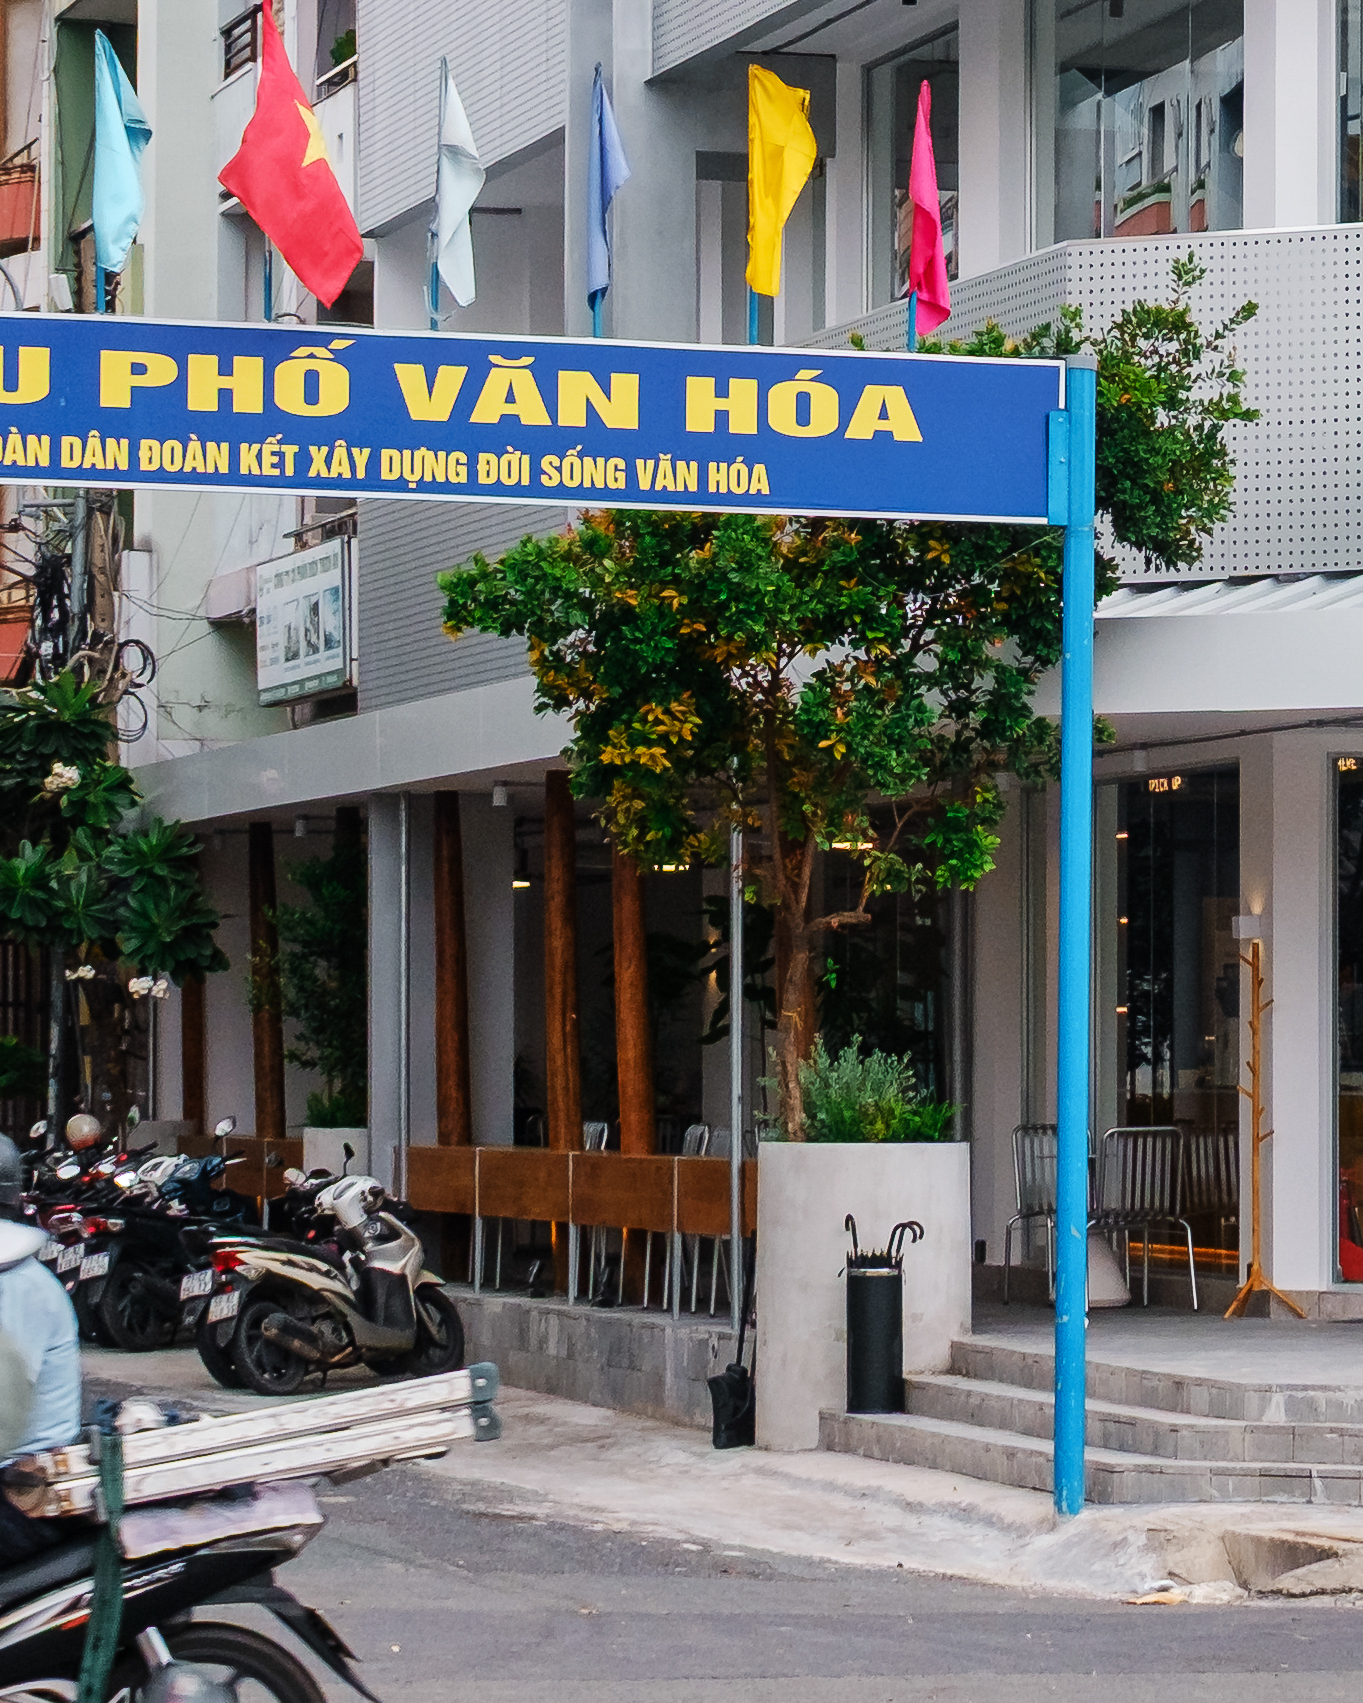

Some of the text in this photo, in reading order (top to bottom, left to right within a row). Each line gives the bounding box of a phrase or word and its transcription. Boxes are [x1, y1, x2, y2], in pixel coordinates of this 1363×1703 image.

[99, 338, 357, 418] PHỐ
[393, 354, 640, 430] VĂN
[685, 368, 924, 443] HÓA
[0, 426, 771, 496] ÀN DÂN ĐOÀN KẾT XÂY DỰNG ĐỜI SỐNG VĂN HÓA
